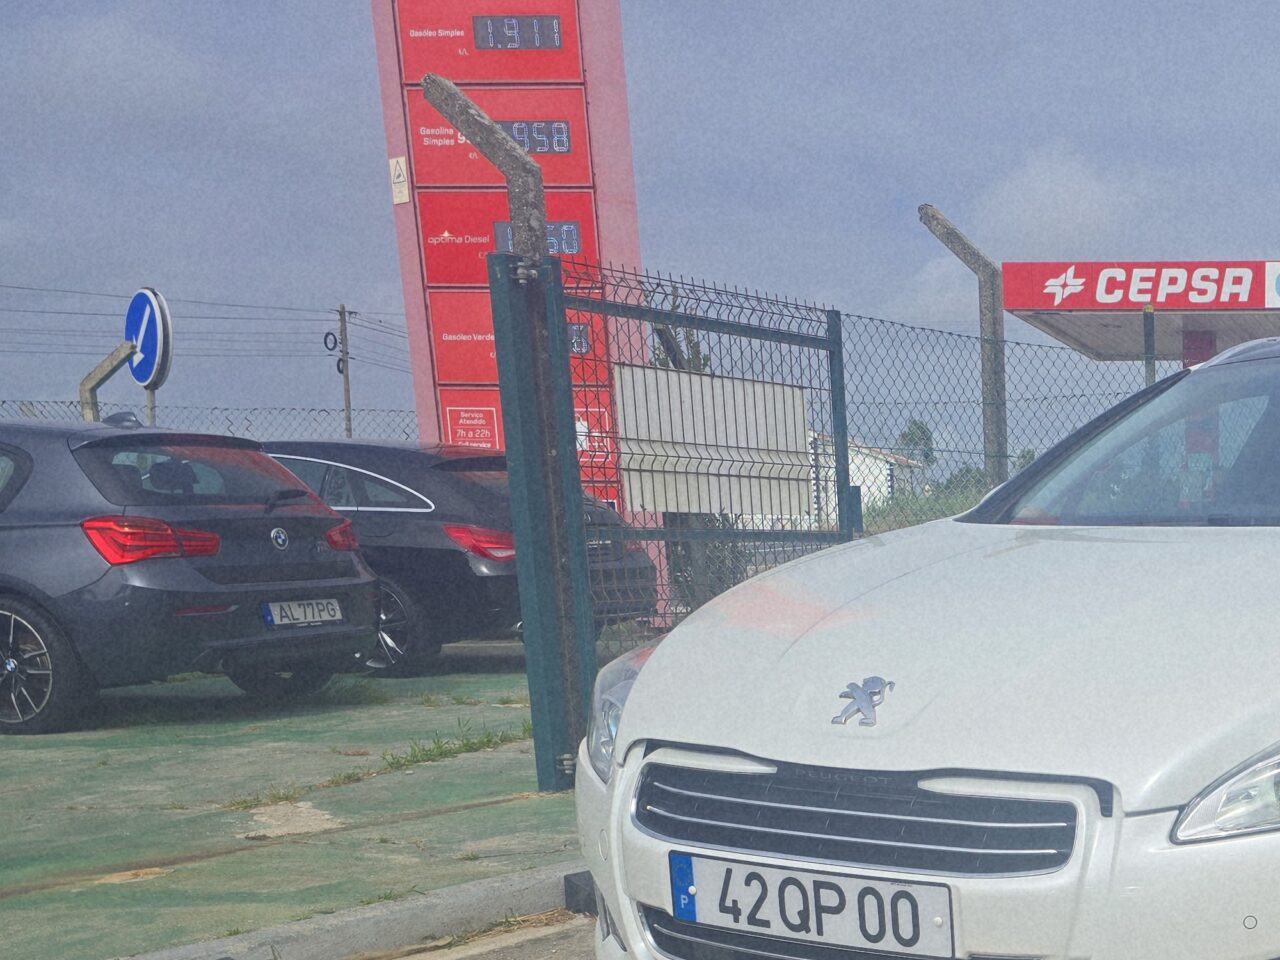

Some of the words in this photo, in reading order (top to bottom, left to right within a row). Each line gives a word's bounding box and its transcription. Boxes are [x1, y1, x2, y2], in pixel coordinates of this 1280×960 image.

[438, 29, 464, 38] Simples
[420, 126, 454, 135] Gasolina
[423, 138, 455, 147] Simples
[464, 234, 490, 244] Diesel
[1096, 267, 1253, 303] CEPSA
[442, 332, 472, 341] Gasóleo
[472, 332, 496, 341] Verde
[456, 429, 467, 438] 7h
[474, 429, 491, 438] 22h
[280, 601, 338, 622] AL77PG
[680, 894, 689, 909] P
[718, 867, 921, 948] 42QP00
